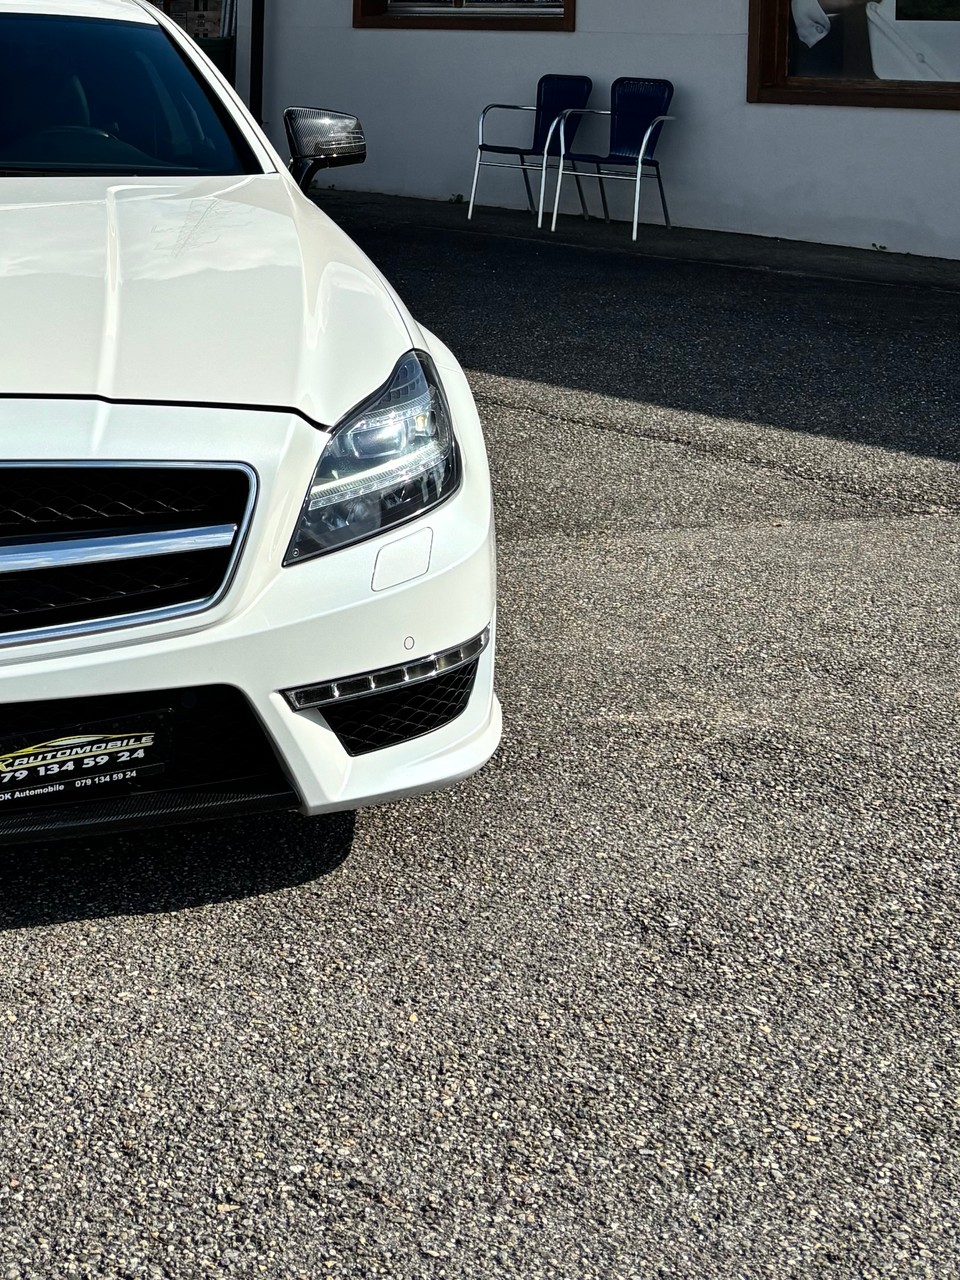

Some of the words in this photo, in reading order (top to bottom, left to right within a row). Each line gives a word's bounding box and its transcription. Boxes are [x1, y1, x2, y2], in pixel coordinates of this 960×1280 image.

[14, 735, 154, 766] AUTOMOBILE
[37, 761, 75, 776] 134
[82, 755, 109, 768] 59
[117, 749, 145, 762] 24
[14, 784, 65, 799] Automobile
[75, 779, 91, 787] 079
[94, 775, 110, 784] 134
[112, 773, 123, 781] 59
[126, 770, 137, 778] 24
